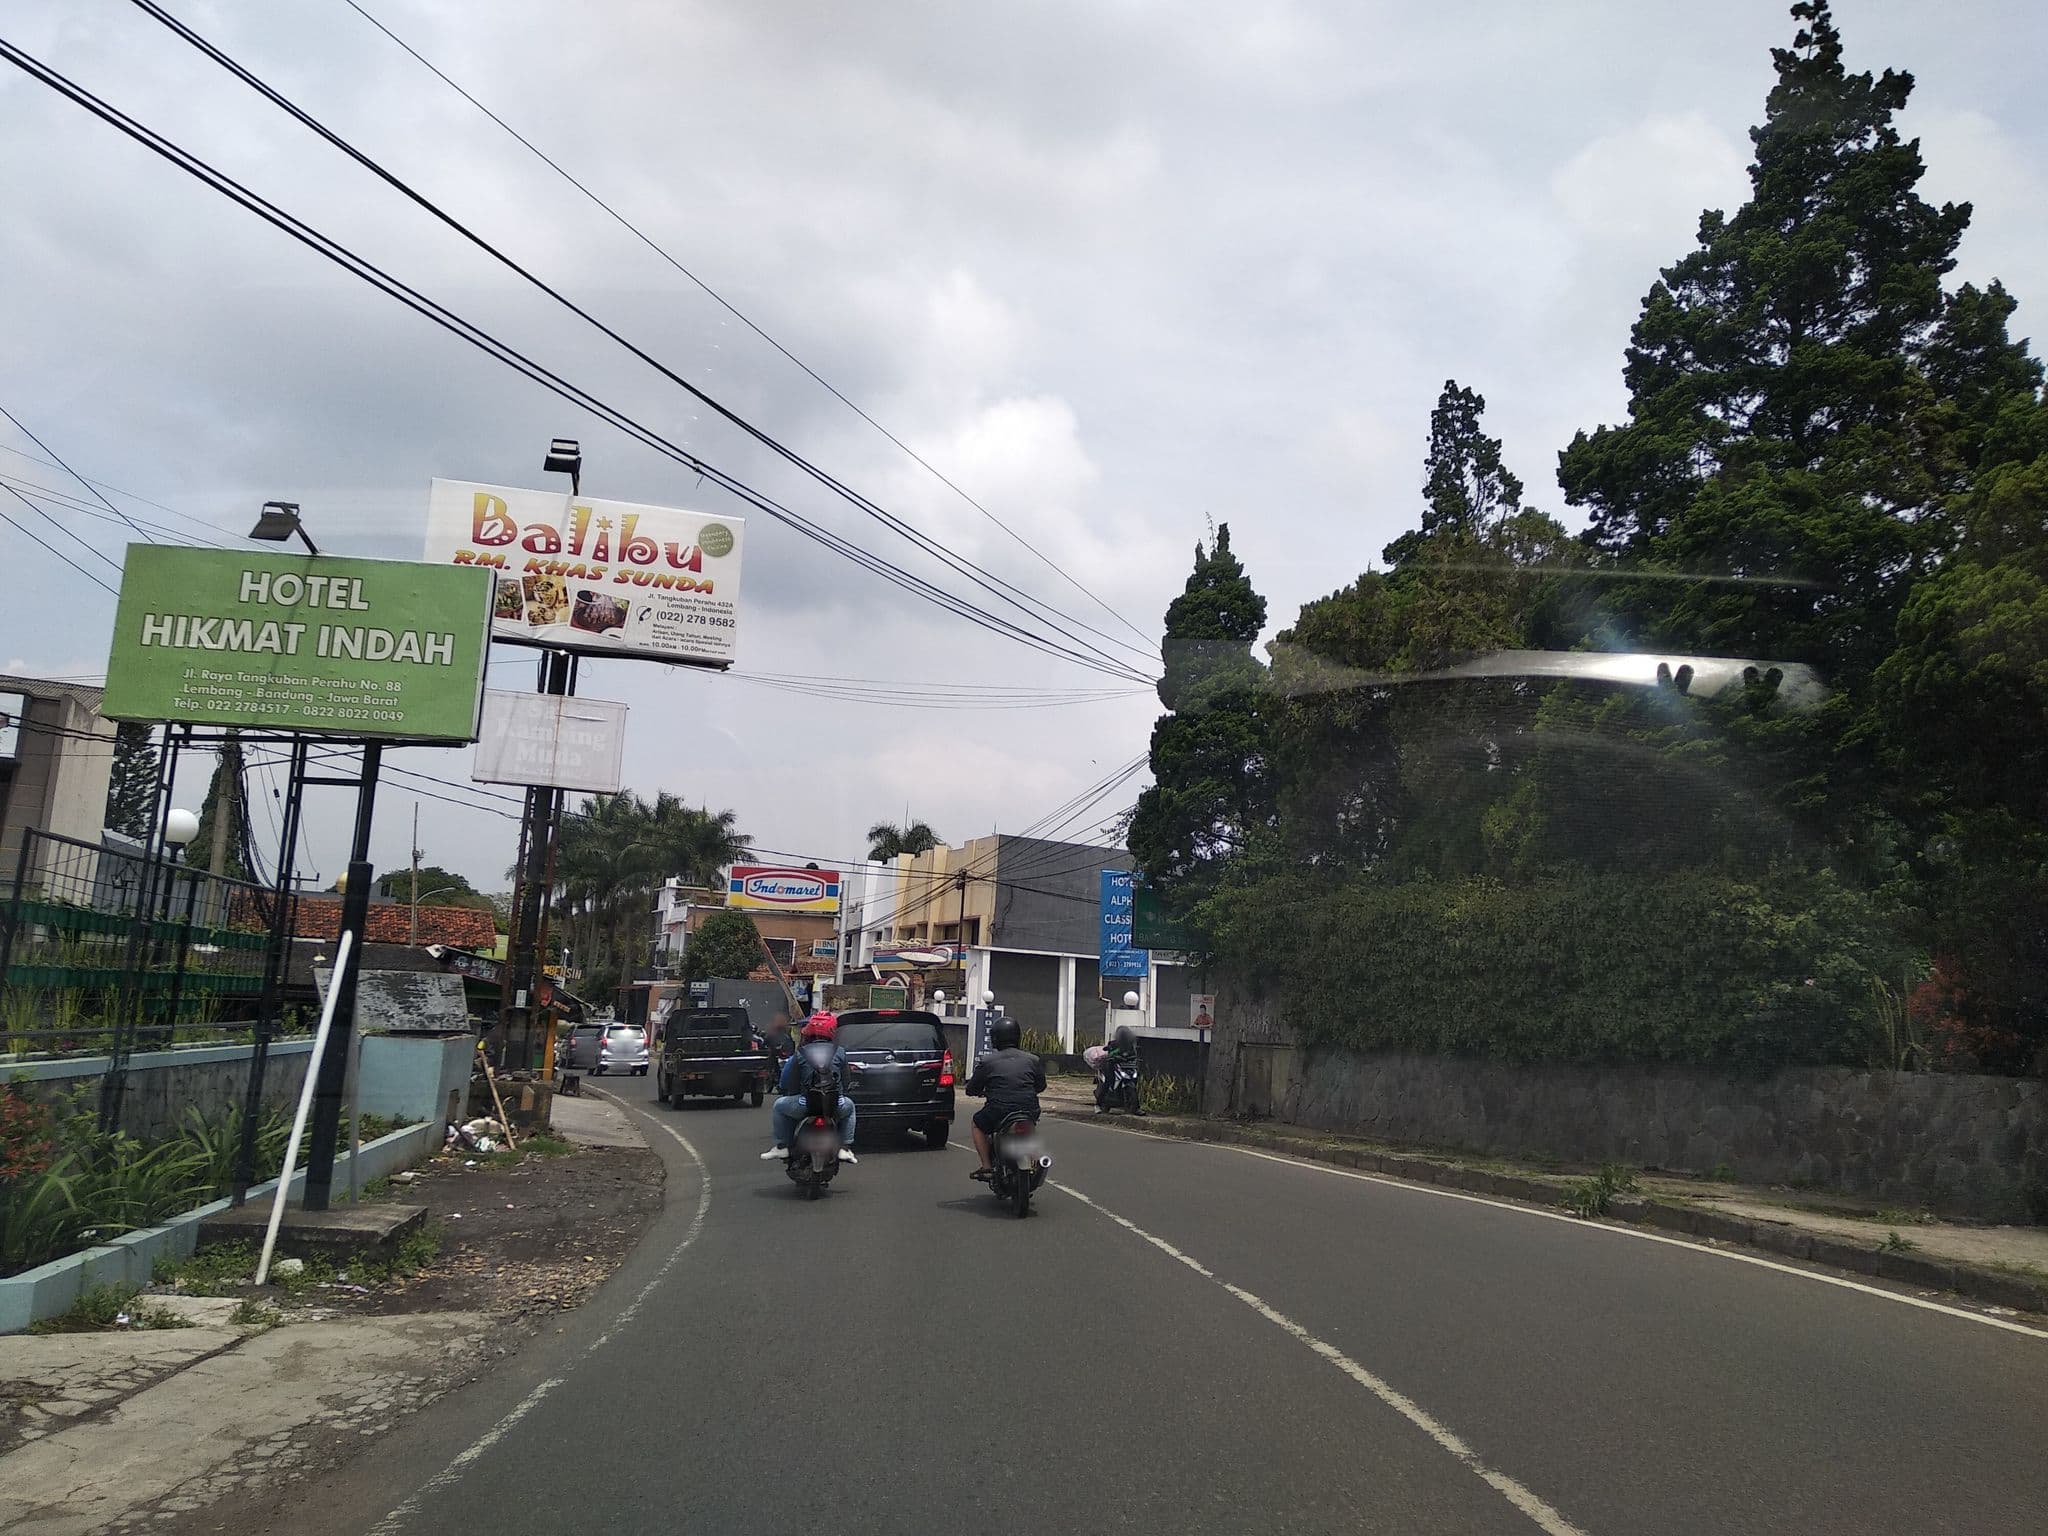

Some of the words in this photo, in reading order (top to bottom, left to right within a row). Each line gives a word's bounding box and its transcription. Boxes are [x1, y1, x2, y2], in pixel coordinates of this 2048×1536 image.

[472, 492, 703, 573] Balibu
[453, 549, 512, 571] RM.
[523, 557, 608, 581] KHAS
[613, 568, 714, 595] SUNDA
[239, 569, 370, 611] HOTEL
[657, 594, 692, 604] Tangkuban
[693, 598, 716, 607] Perahu
[656, 610, 684, 624] (022)
[687, 614, 706, 625] 278
[709, 616, 735, 628] 9582
[666, 603, 697, 612] Lembang
[701, 607, 733, 615] Indonesia
[140, 613, 306, 655] HIKMAT
[316, 625, 455, 665] INDAH
[183, 668, 197, 680] Jl.
[201, 669, 233, 683] Raya
[237, 671, 308, 686] Tangkuban
[312, 676, 356, 690] Perahu
[360, 680, 382, 691] No.
[386, 681, 402, 692] 88
[183, 683, 243, 699] Lembang
[256, 687, 314, 704] Bandung
[327, 693, 359, 705] Jawa
[363, 694, 399, 707] Barat
[173, 697, 203, 712] Telp.
[207, 699, 231, 712] 022
[235, 701, 290, 715] 2784517
[303, 705, 334, 718] 0822
[338, 707, 369, 720] 8022
[373, 709, 404, 722] 0049
[750, 879, 820, 897] Indomaret
[549, 965, 582, 981] BENSIN
